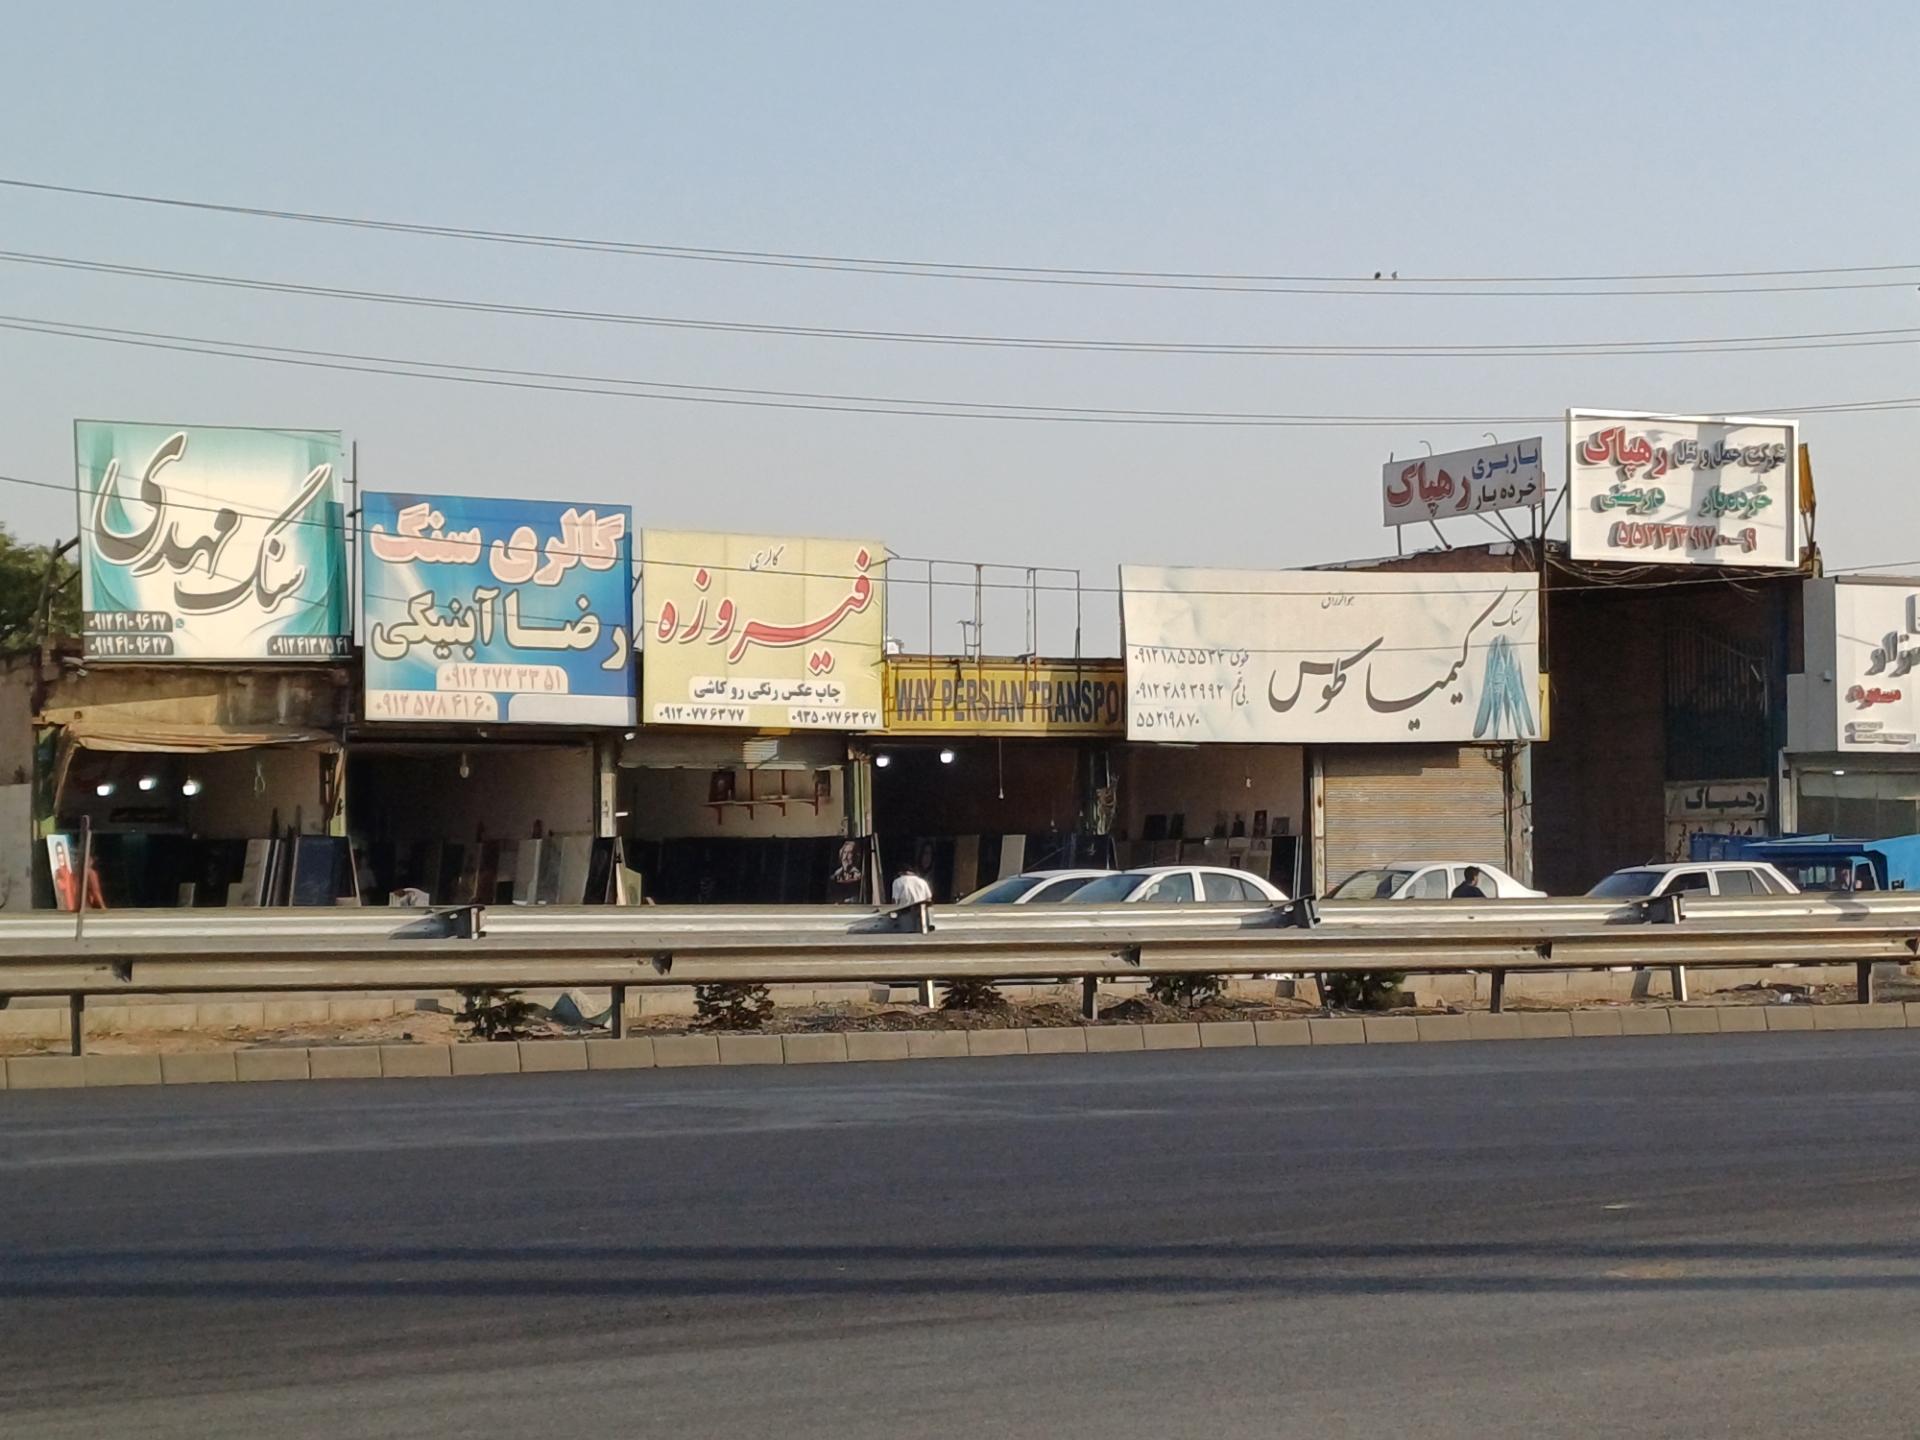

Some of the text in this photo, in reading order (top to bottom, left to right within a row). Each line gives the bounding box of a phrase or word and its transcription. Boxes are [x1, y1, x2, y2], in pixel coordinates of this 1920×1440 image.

[1472, 444, 1538, 480] باربری
[1582, 426, 1668, 480] رهپاک
[1714, 440, 1741, 467] حمل
[1386, 460, 1472, 517] رهپاک
[369, 502, 625, 586] گالری سنگ
[504, 588, 630, 670] رضا
[657, 548, 874, 676] فیروزه
[1268, 635, 1385, 714] طوس
[1365, 585, 1508, 731] کیمیا
[693, 680, 842, 702] چاپ عکس رنگی رو کاشی
[941, 678, 1024, 722] PERSIAN
[1028, 679, 1125, 724] TRANSPO
